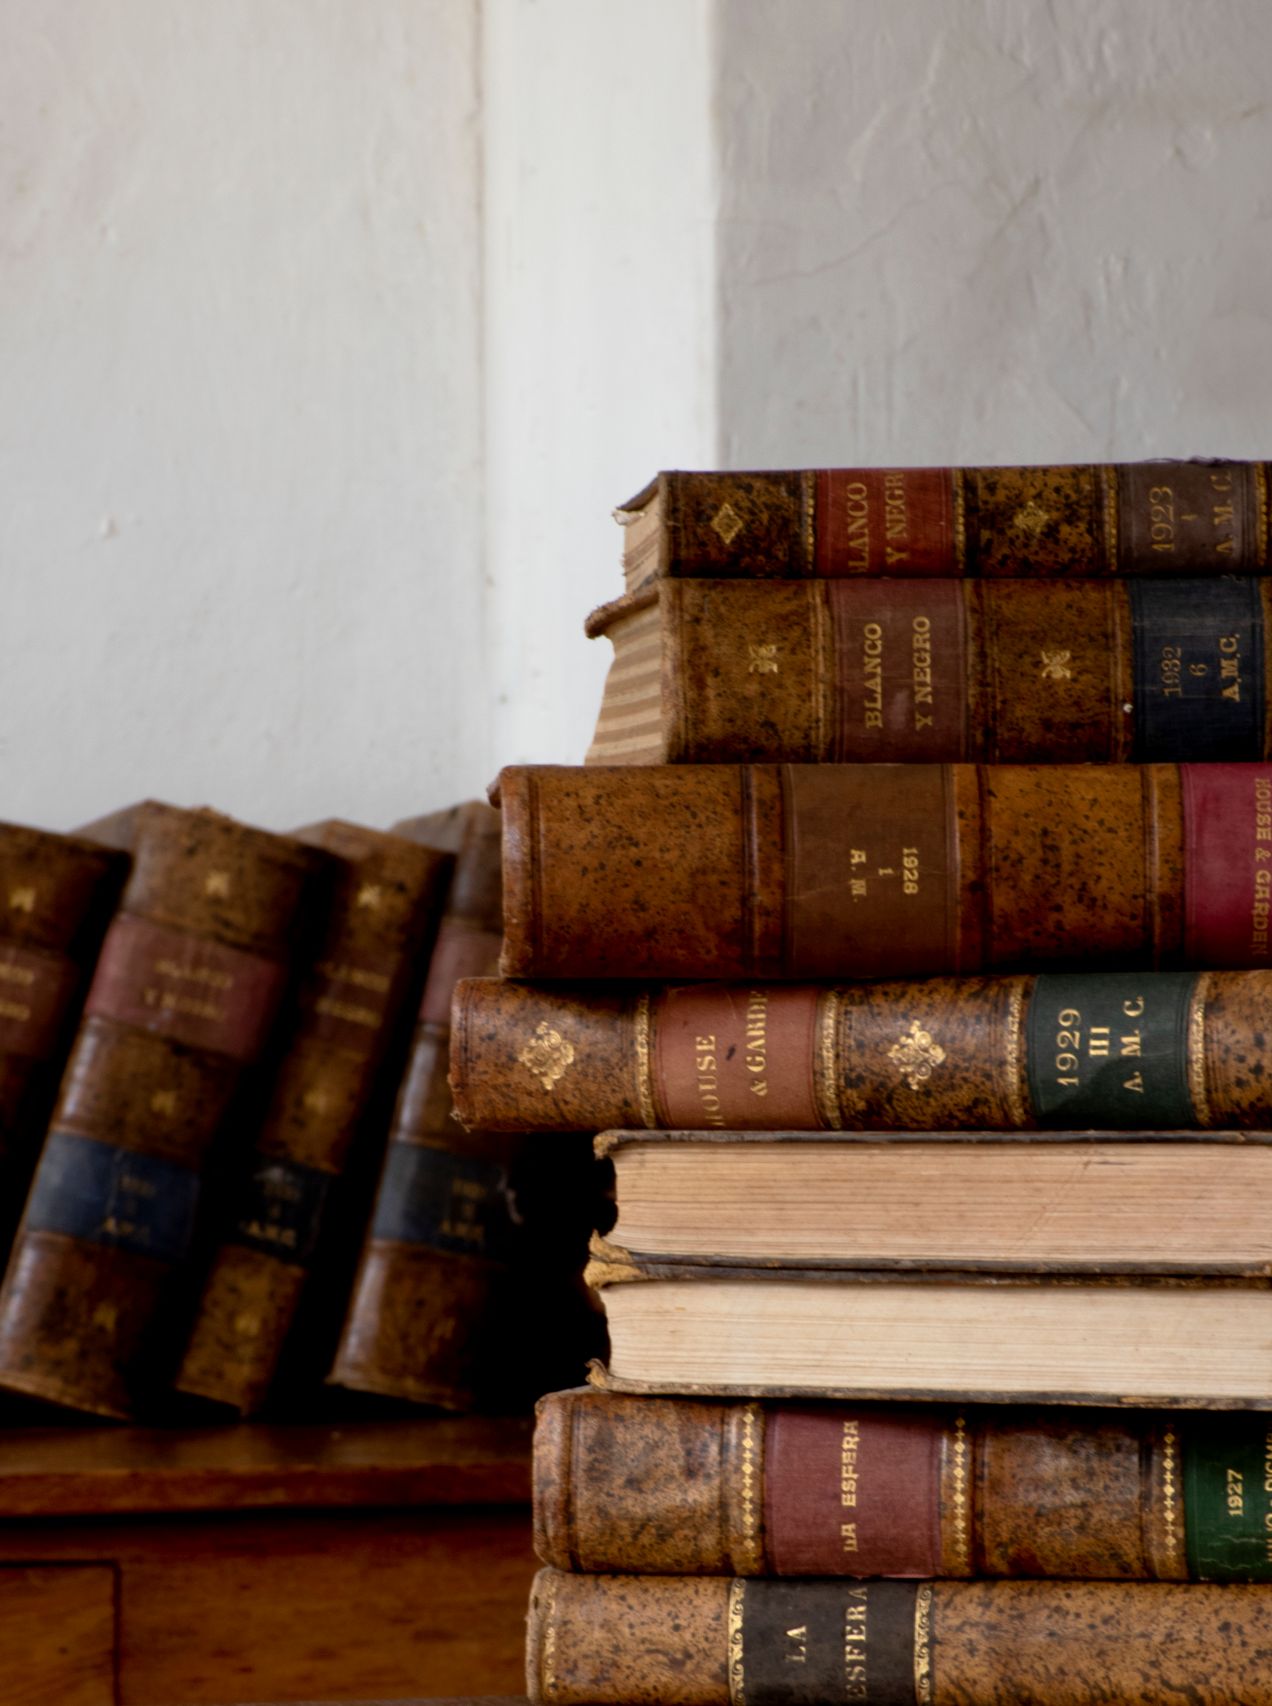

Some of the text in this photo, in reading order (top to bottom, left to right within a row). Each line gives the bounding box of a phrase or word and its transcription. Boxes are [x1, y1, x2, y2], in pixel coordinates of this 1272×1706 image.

[847, 482, 869, 574] LANCO
[1149, 485, 1175, 552] 1923
[885, 547, 910, 566] Y
[864, 622, 884, 729] BLANCO
[913, 615, 933, 731] Y NEGRO
[1189, 663, 1208, 677] 6
[1255, 778, 1272, 840] HOUSE
[903, 847, 918, 894] 1928
[1255, 847, 1271, 863] &
[1056, 1008, 1081, 1086] 1929
[1088, 1027, 1110, 1057] III
[751, 1079, 768, 1097] &
[841, 1420, 860, 1552] LA ESFERA
[1227, 1468, 1243, 1517] 1927
[785, 1625, 807, 1663] LA
[845, 1586, 867, 1699] ESFERA
